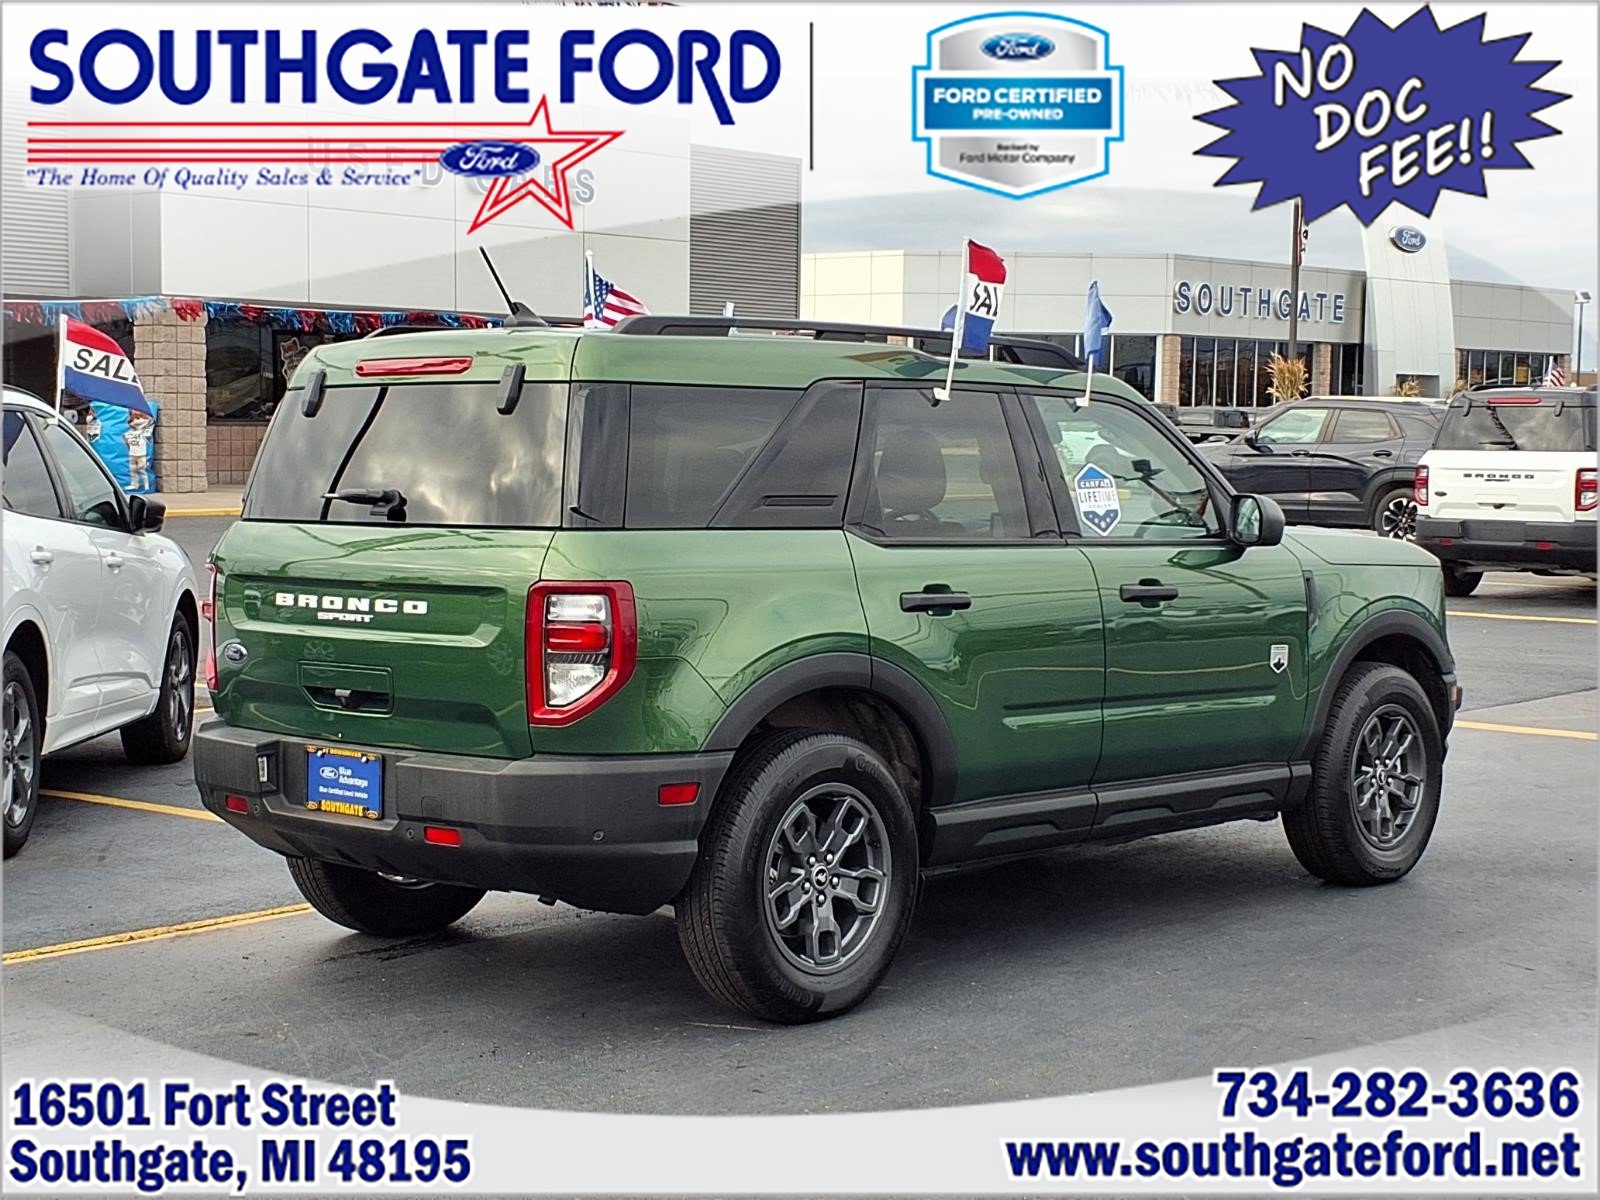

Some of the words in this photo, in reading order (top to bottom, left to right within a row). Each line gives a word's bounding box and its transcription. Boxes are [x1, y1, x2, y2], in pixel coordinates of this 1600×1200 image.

[1175, 280, 1345, 322] SOUTHGATE
[73, 348, 139, 384] SAL
[275, 592, 428, 615] BRONCO
[317, 612, 374, 623] SPORT
[339, 766, 352, 776] Blue
[339, 776, 369, 788] Advantage
[321, 800, 363, 817] SOUTHGATE
